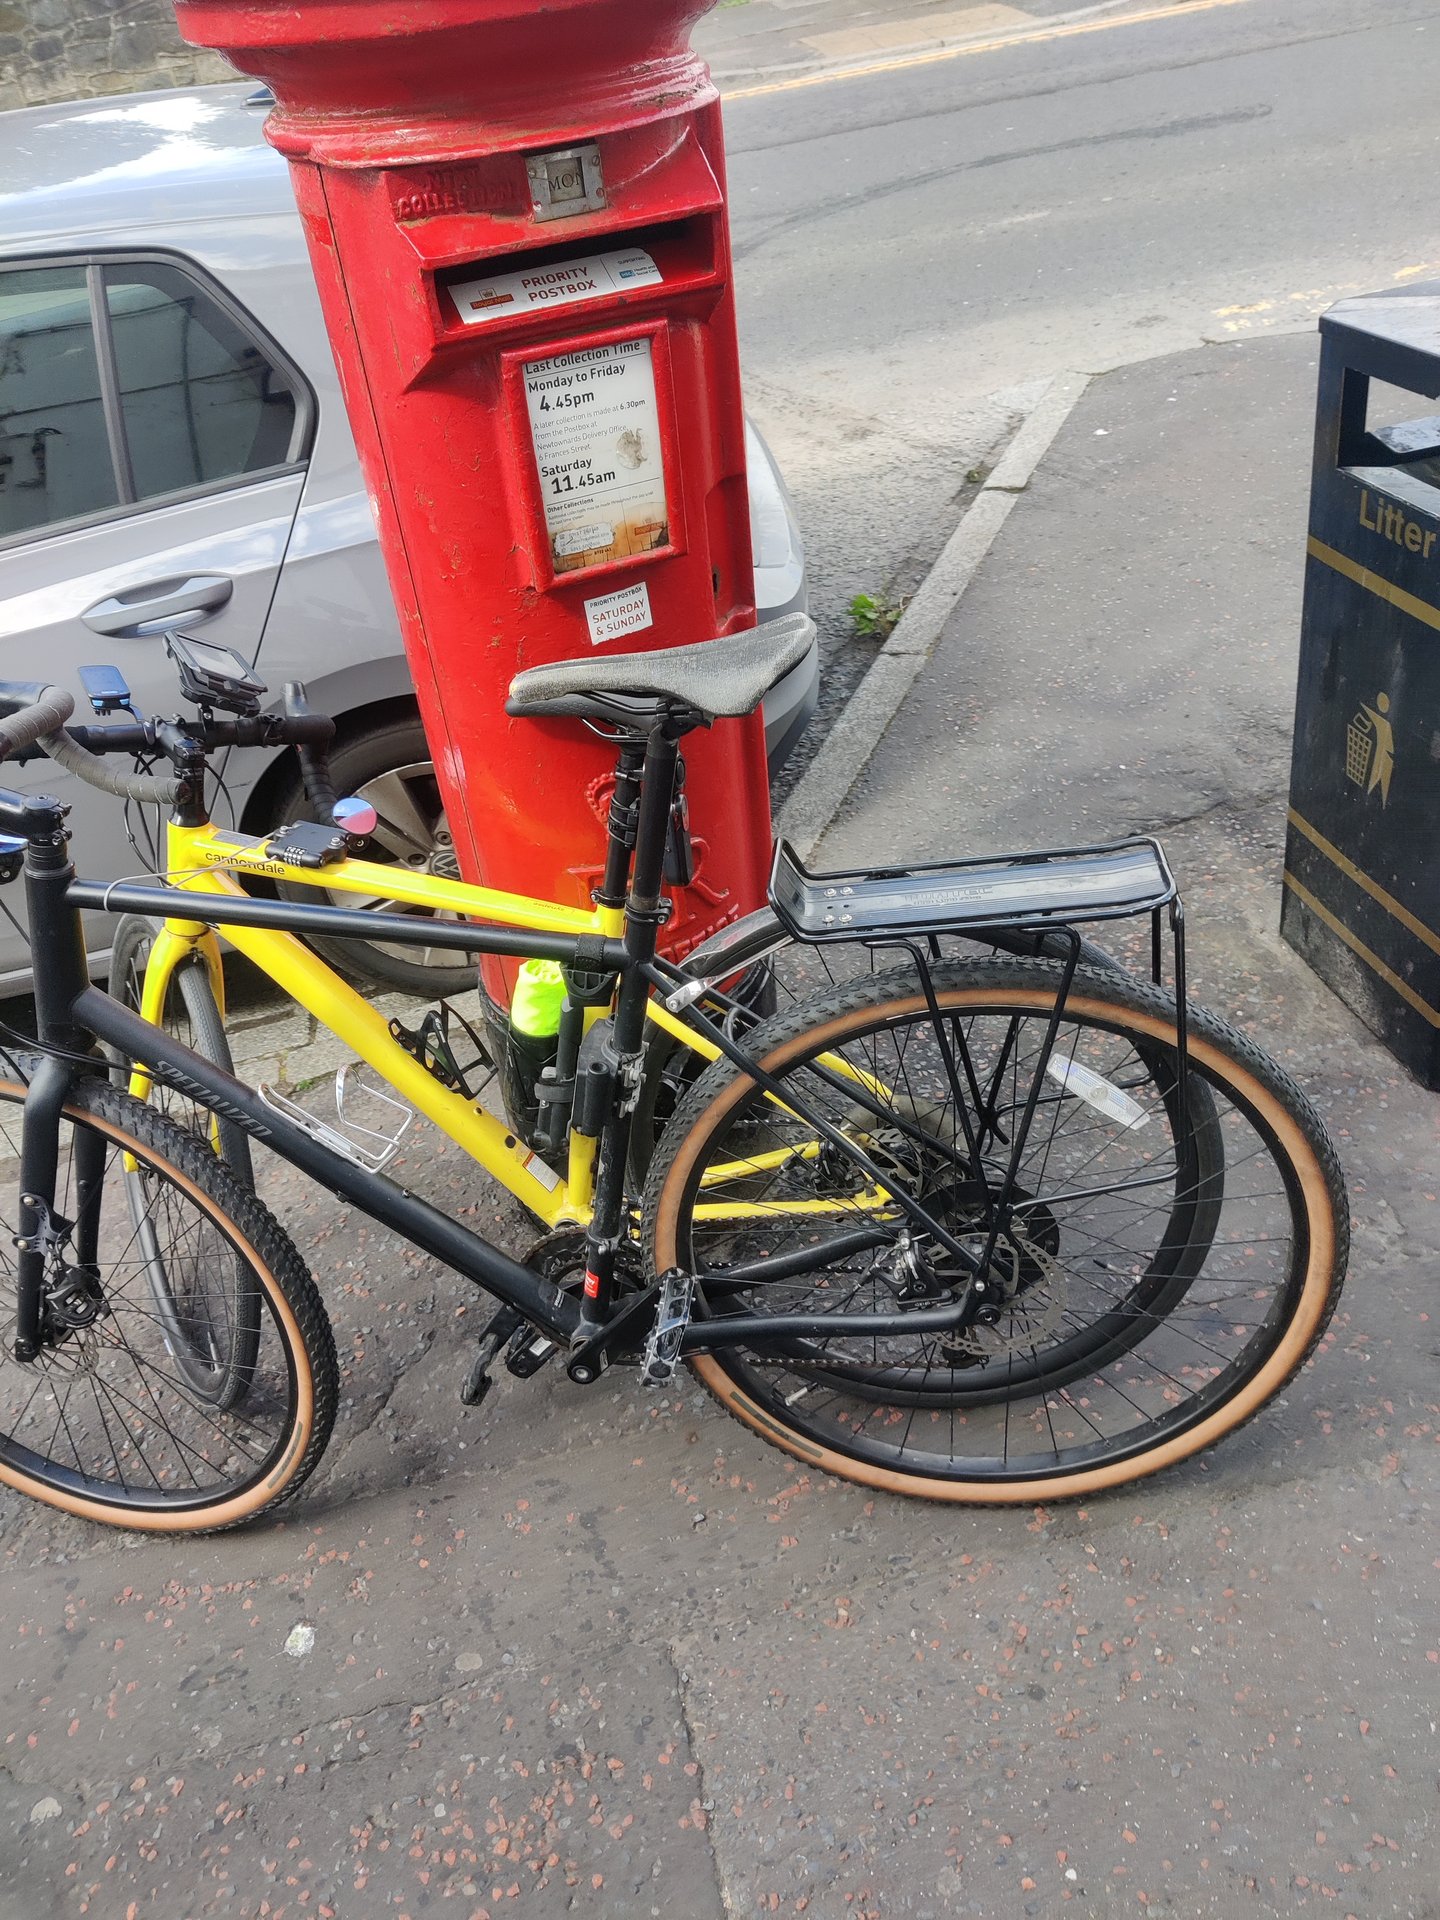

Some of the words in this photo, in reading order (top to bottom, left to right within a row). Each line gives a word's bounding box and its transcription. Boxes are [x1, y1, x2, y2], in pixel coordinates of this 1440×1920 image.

[521, 266, 589, 289] PRIORITY
[528, 279, 598, 302] POSTBOX
[525, 361, 551, 374] Last
[553, 348, 609, 368] Collection
[613, 341, 640, 355] Time
[528, 375, 573, 393] Monday
[575, 373, 588, 383] to
[590, 364, 626, 380] Friday
[539, 391, 594, 412] 4.45pm
[540, 420, 555, 429] later
[556, 413, 586, 425] collection
[587, 411, 592, 419] is
[593, 408, 611, 417] made
[612, 405, 619, 413] at
[619, 399, 646, 411] 6.30pm
[535, 431, 552, 440] from
[552, 428, 564, 437] the
[564, 423, 590, 434] Postbox
[590, 421, 598, 429] at
[537, 434, 581, 451] Newtownards
[582, 428, 608, 441] Delivery
[544, 448, 570, 461] Frances
[571, 443, 591, 454] Street
[541, 458, 592, 477] Saturday
[551, 471, 616, 494] 11.45am
[547, 505, 563, 513] Other
[564, 498, 594, 509] Collections
[1359, 489, 1437, 559] Litter
[590, 596, 616, 608] PRIORITY
[617, 586, 643, 599] POSTBOX
[592, 598, 644, 624] SATURDAY
[596, 626, 604, 636] &
[606, 611, 646, 633] SUNDAY
[205, 851, 285, 875] cannondale
[157, 1060, 273, 1137] SPECIALIZED
